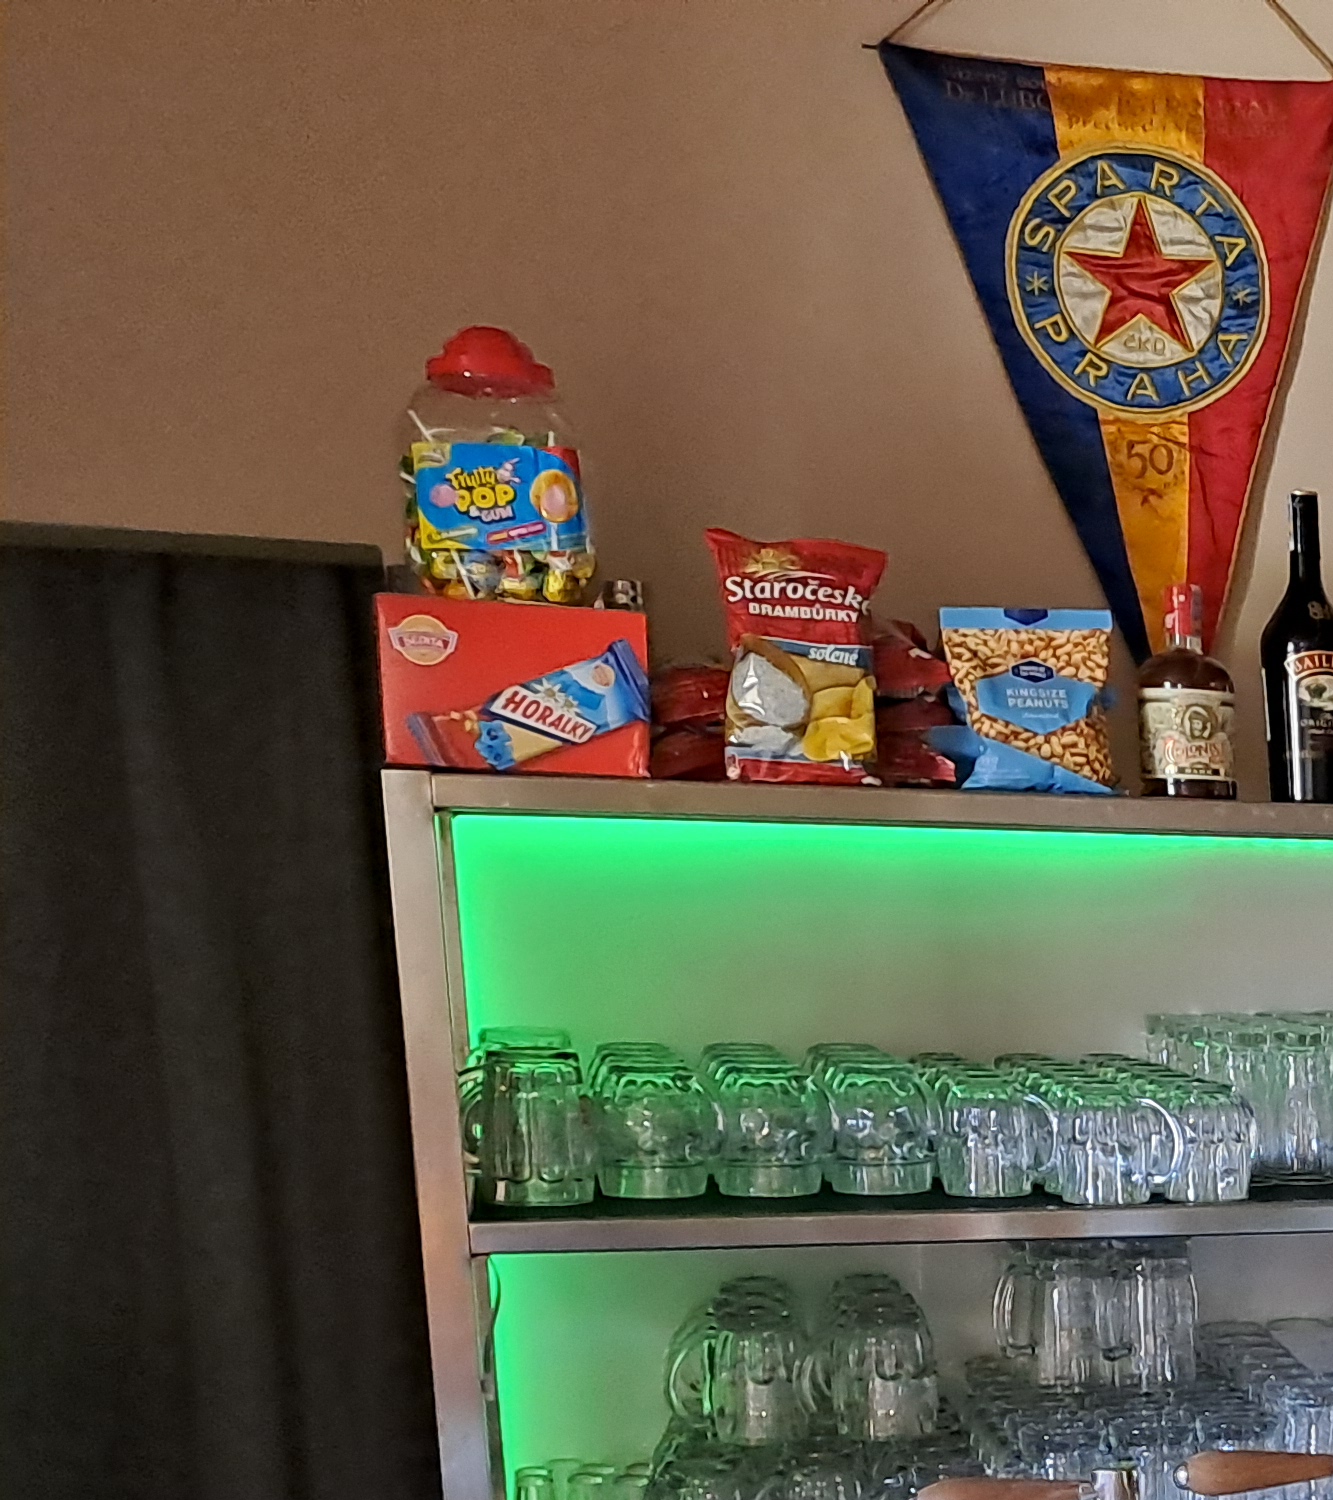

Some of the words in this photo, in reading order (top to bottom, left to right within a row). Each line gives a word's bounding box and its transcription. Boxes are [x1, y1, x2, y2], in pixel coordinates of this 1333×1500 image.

[1023, 159, 1248, 267] SPARTA
[1033, 311, 1249, 402] PRAHA
[1126, 439, 1175, 479] 50
[454, 483, 516, 513] POP
[1006, 687, 1067, 699] KINGSIZE
[1007, 697, 1069, 710] PEANUTS
[500, 690, 595, 743] HORALKY
